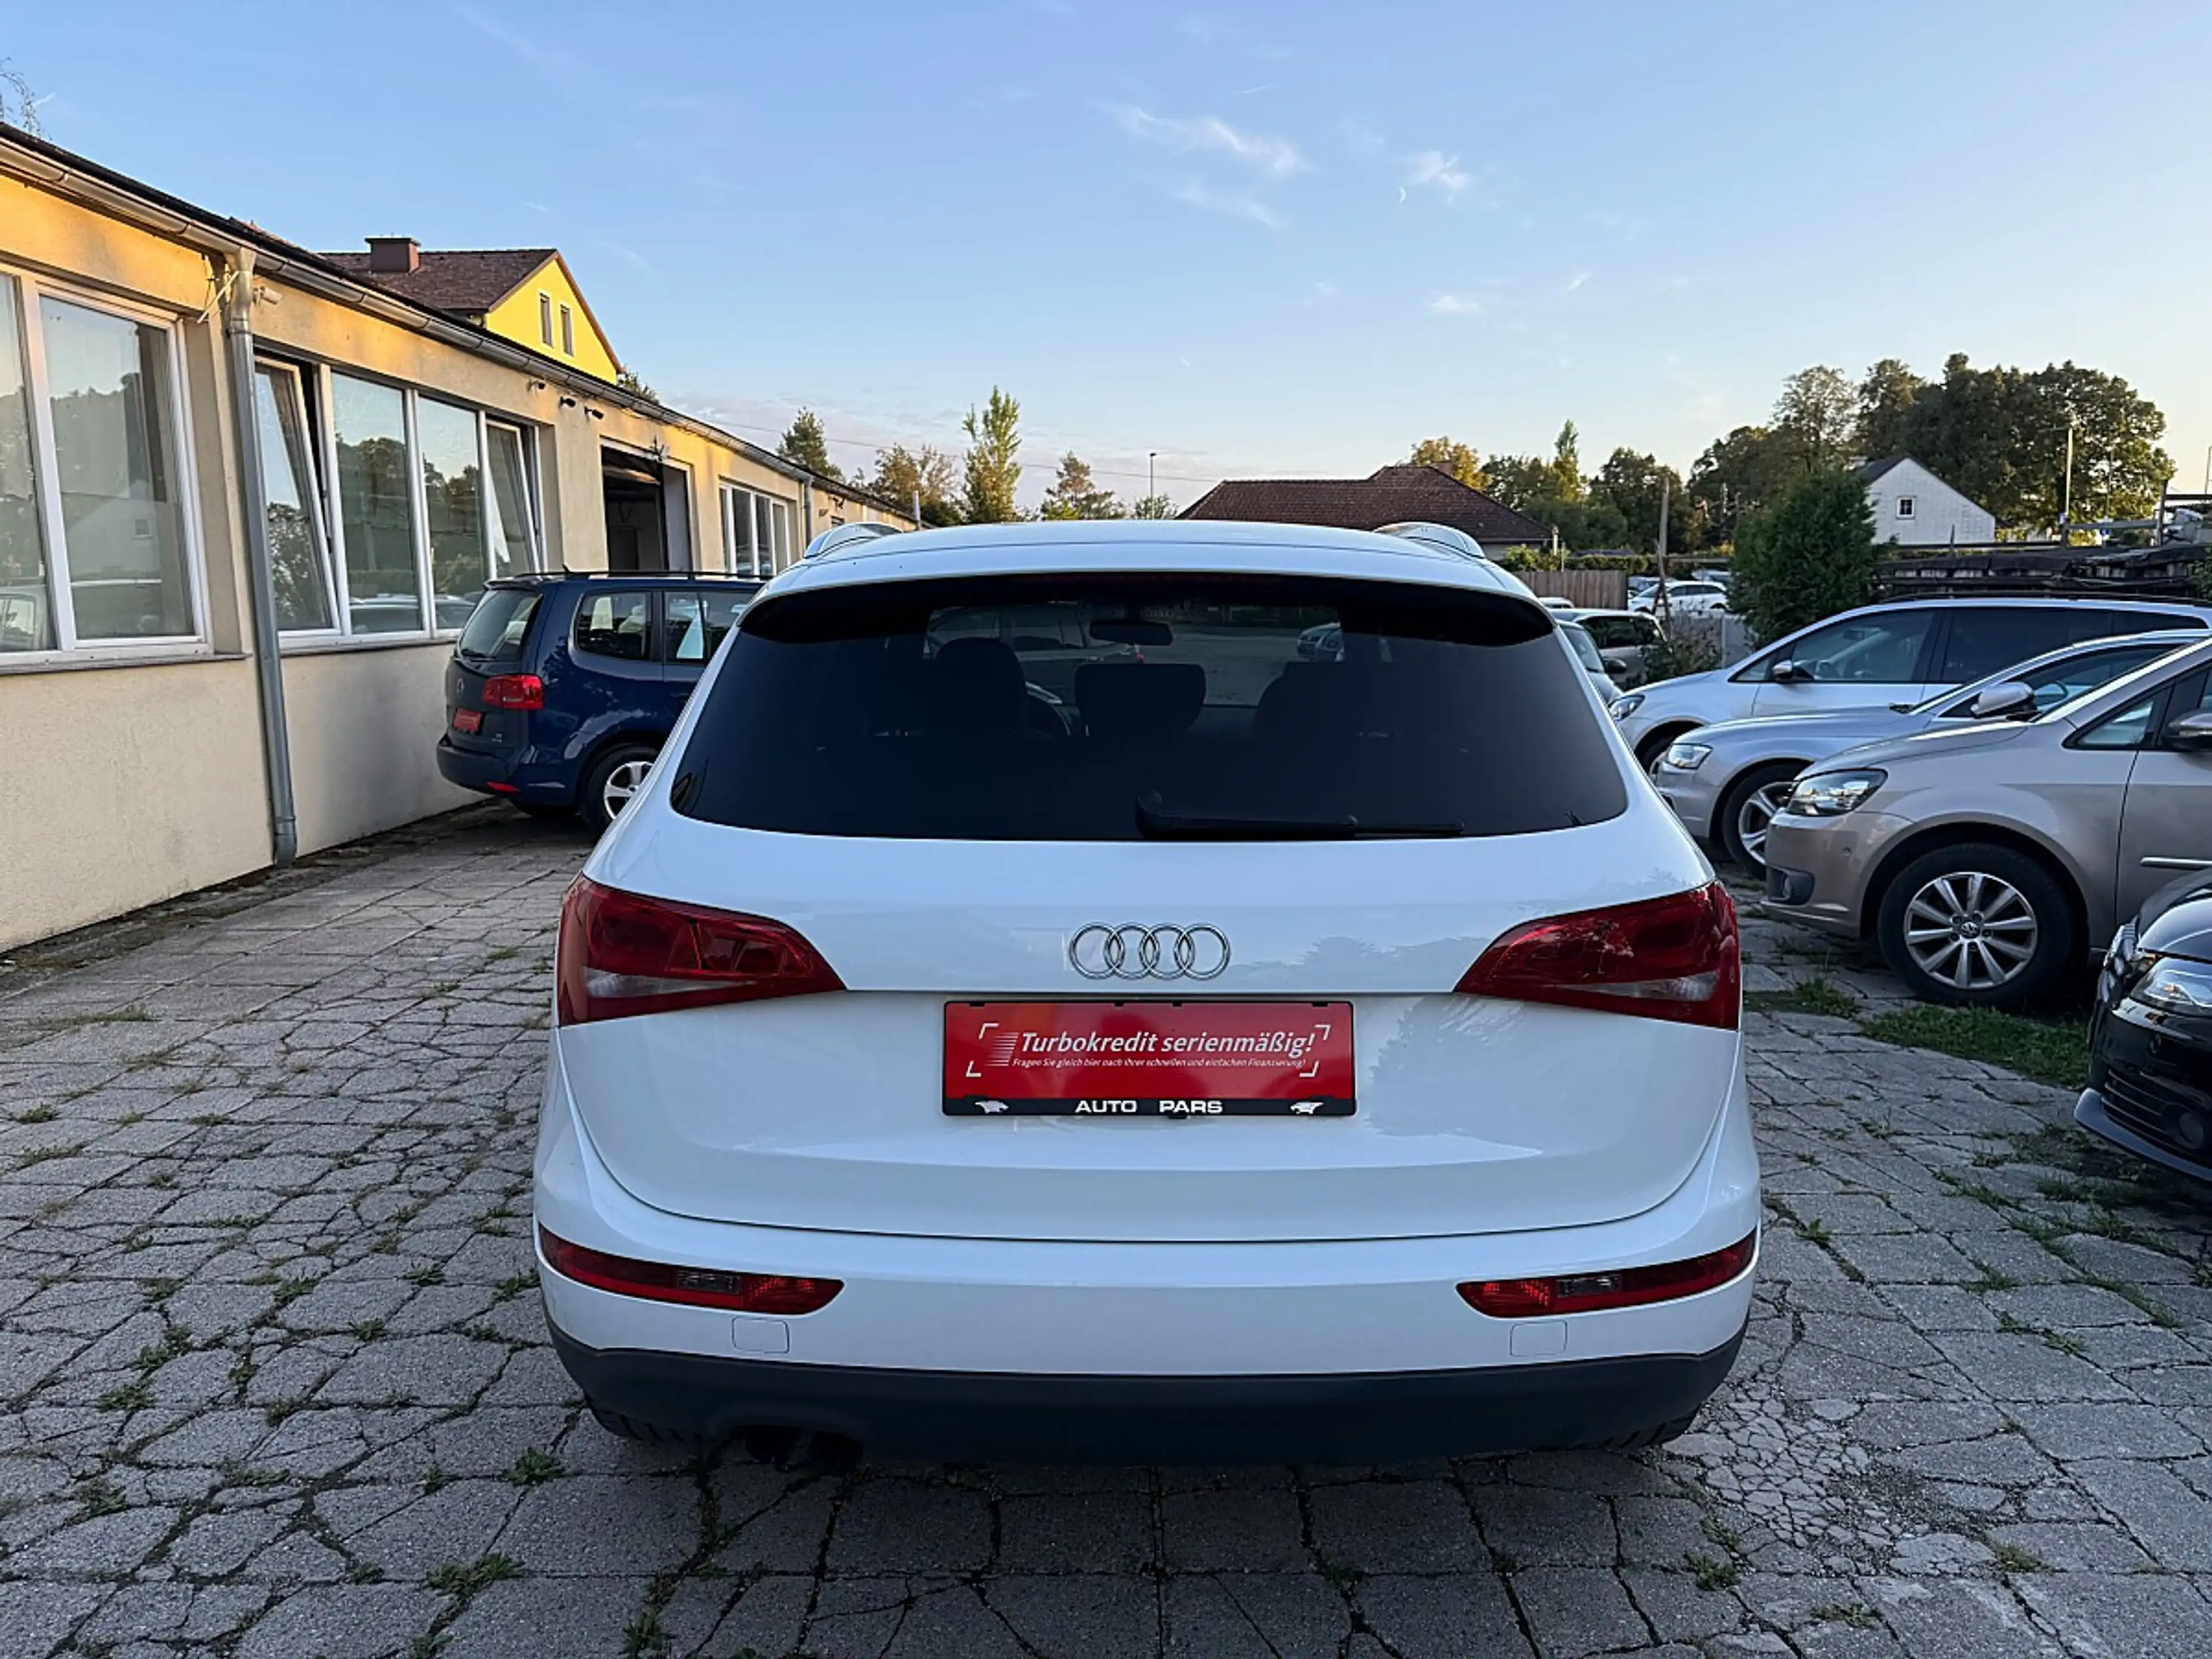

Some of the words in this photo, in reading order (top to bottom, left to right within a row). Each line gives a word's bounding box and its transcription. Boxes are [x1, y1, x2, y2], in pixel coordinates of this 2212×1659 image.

[1022, 1031, 1158, 1052] Turbokredit
[1161, 1031, 1315, 1059] serienmäßig!
[1012, 1058, 1042, 1069] Fragen
[1043, 1058, 1056, 1066] Sie
[1056, 1058, 1083, 1069] gleich
[1187, 1058, 1205, 1066] und
[1074, 1100, 1138, 1113] AUTO
[1159, 1100, 1223, 1114] PARS
